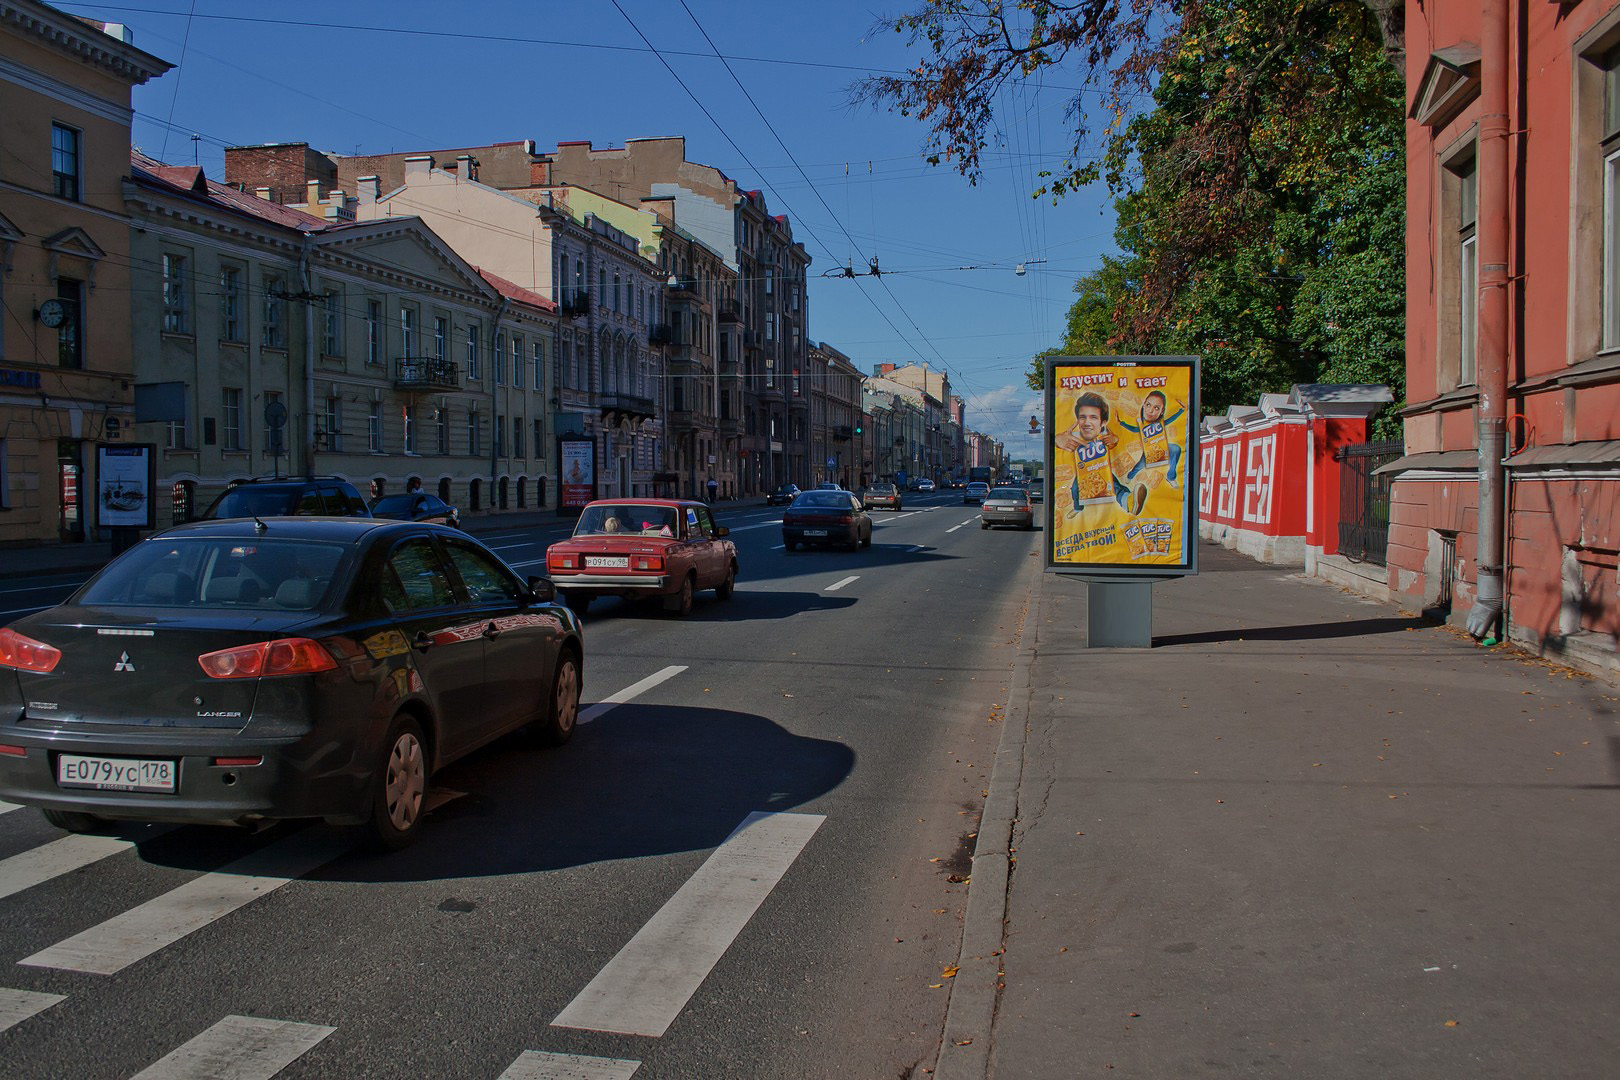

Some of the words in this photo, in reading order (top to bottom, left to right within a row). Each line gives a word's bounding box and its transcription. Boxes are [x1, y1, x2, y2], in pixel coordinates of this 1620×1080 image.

[1062, 373, 1113, 389] хрустит
[1118, 377, 1128, 387] и
[1136, 376, 1167, 387] тает
[1143, 422, 1163, 437] TUC
[1078, 441, 1106, 461] TUC
[1055, 533, 1084, 547] ВСЕГДА
[1084, 525, 1115, 539] ВКУСНЫЙ
[1056, 544, 1085, 557] ВСЕГДА
[1086, 532, 1117, 549] ТВОЙ!
[142, 762, 169, 779] 178
